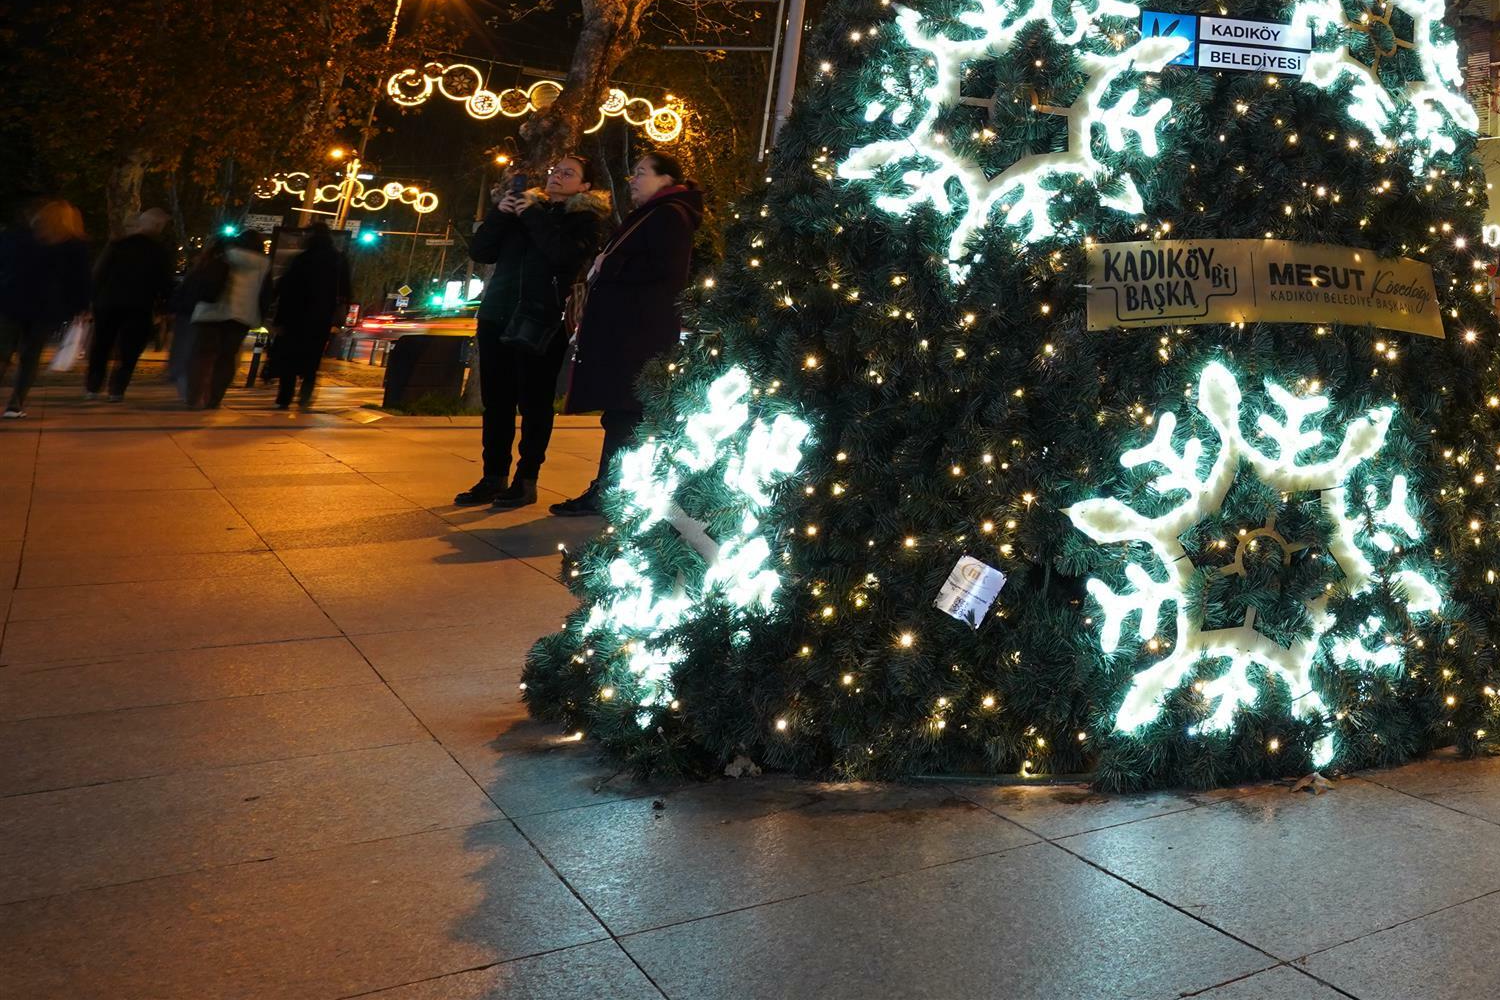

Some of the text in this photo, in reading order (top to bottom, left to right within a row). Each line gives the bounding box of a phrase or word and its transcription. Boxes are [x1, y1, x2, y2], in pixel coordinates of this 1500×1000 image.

[1212, 24, 1281, 42] KADIKÖY
[1210, 51, 1301, 71] BELEDİYESİ
[1103, 247, 1215, 283] KADIKÖY
[1268, 262, 1365, 292] MESUT
[1124, 280, 1199, 315] BAŞKA
[1270, 289, 1319, 303] KADIKÖY
